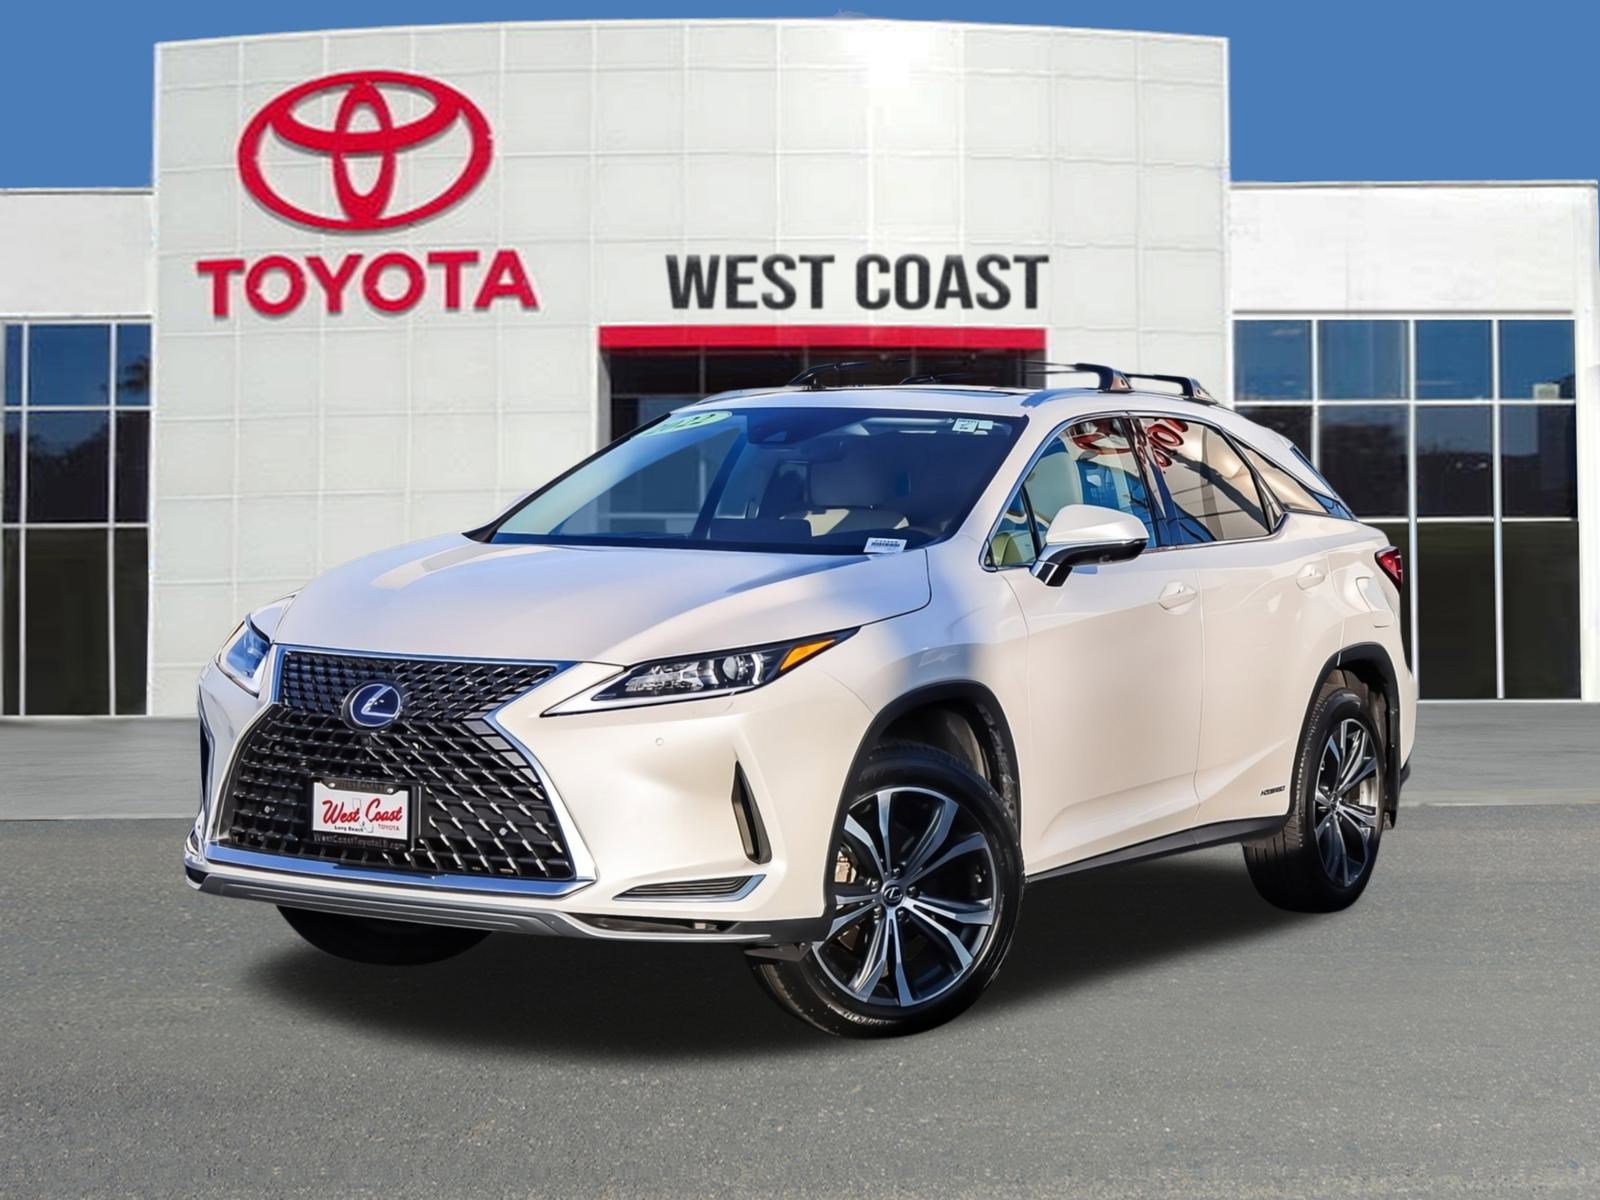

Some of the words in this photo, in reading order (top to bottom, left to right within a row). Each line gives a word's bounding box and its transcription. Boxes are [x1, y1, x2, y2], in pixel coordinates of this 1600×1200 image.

[196, 250, 538, 318] TOYOTA
[666, 254, 835, 310] WEST
[856, 254, 1050, 310] COAST
[322, 800, 361, 824] West
[365, 798, 403, 822] Coast
